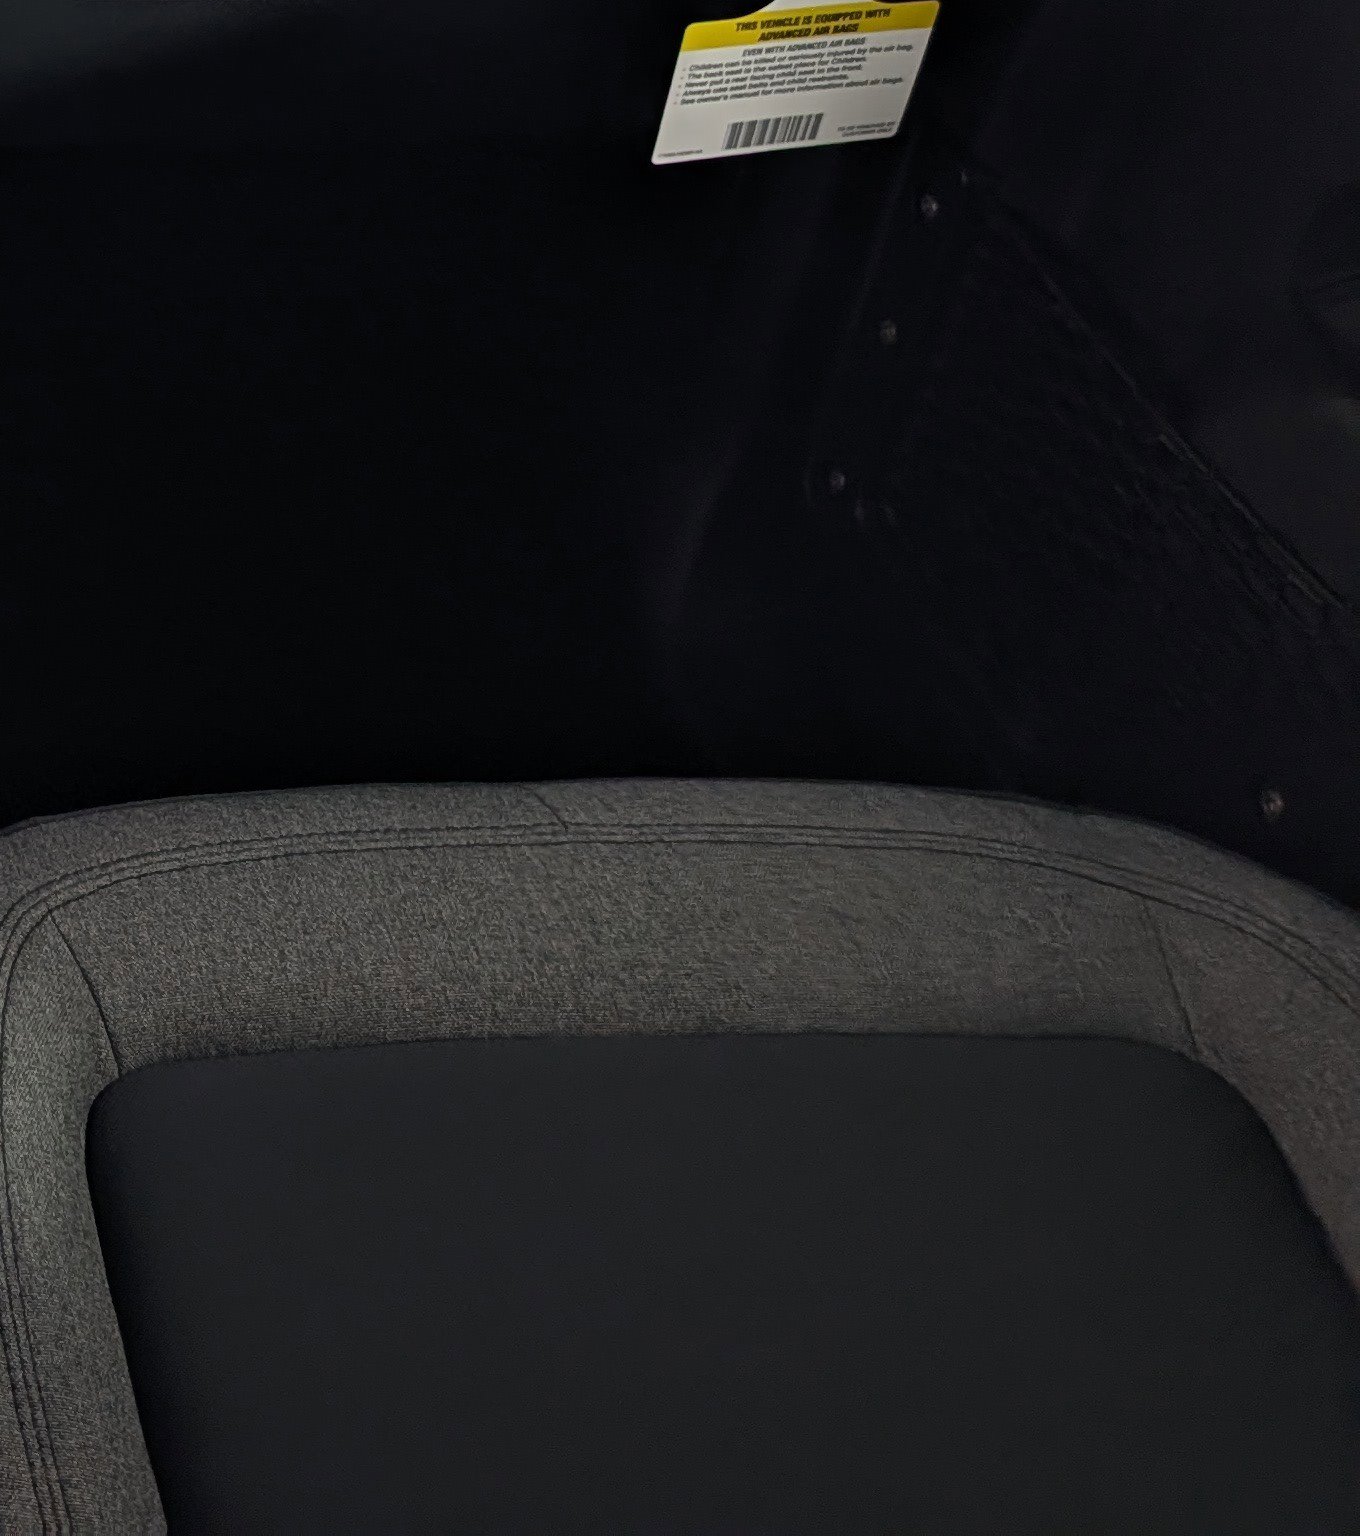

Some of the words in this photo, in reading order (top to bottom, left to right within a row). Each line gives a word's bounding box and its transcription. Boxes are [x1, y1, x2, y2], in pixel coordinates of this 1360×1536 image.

[735, 20, 758, 32] THIS
[760, 15, 801, 30] VEHICLE
[801, 14, 813, 26] IS
[814, 9, 863, 25] EQUIPPED
[864, 7, 891, 20] WITH
[757, 26, 812, 42] ADVANCED
[812, 24, 832, 37] AIR
[832, 22, 860, 36] BAGS
